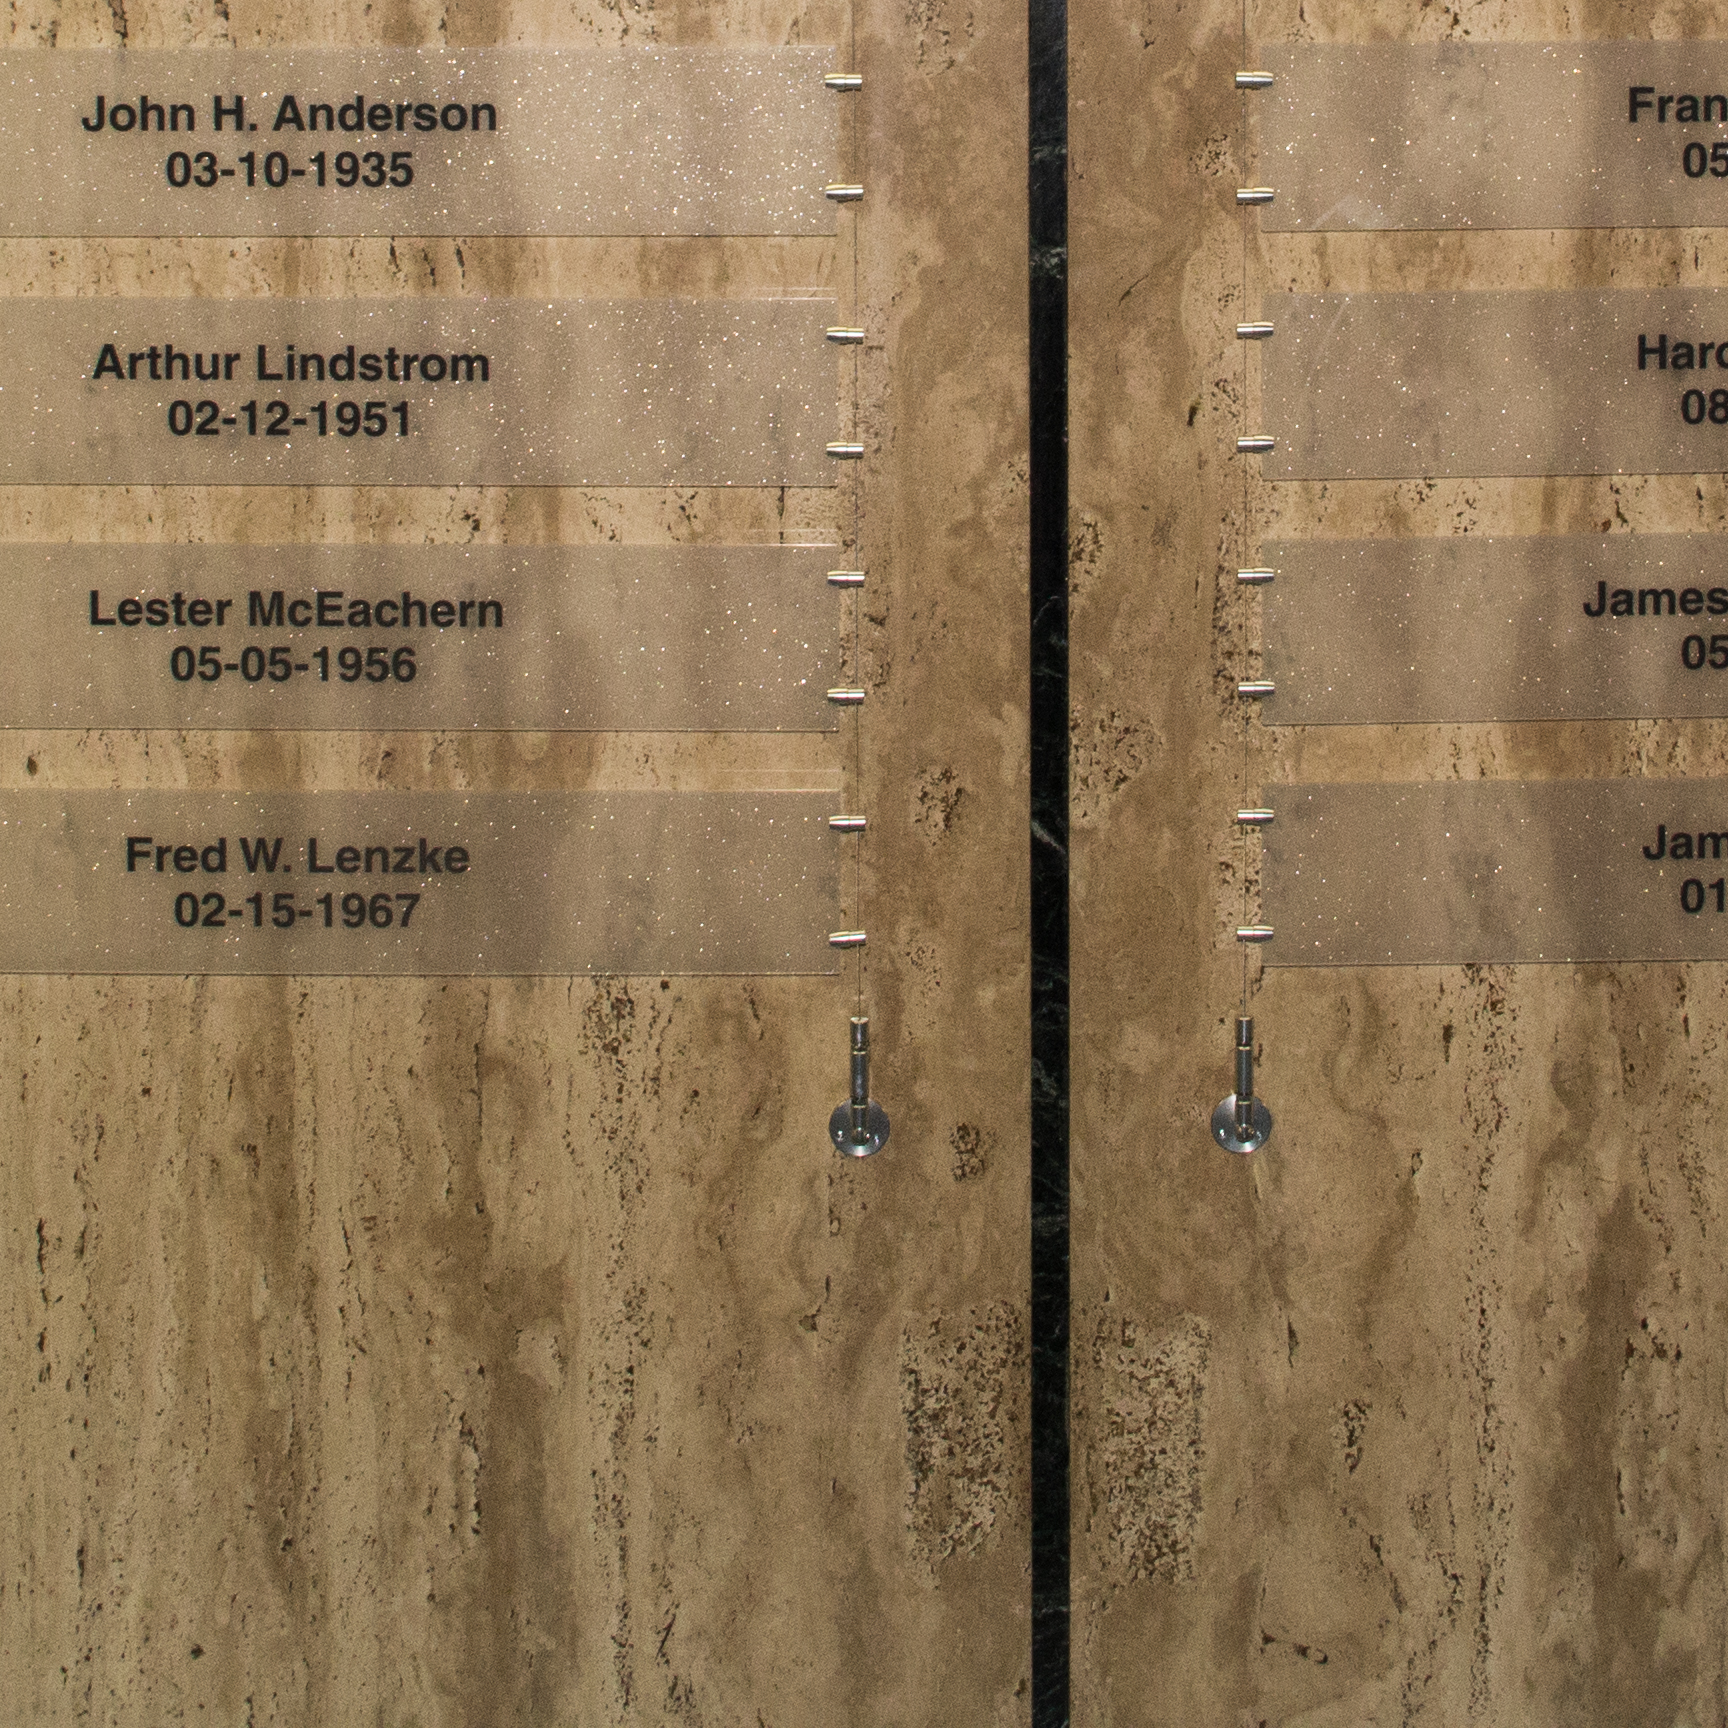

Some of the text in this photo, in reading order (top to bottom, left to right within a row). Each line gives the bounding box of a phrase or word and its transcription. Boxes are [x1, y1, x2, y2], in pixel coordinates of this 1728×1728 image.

[82, 95, 496, 132] John H. Anderson
[166, 151, 414, 188] 03-10-1935
[94, 344, 489, 382] Arthur Lindstrom
[169, 401, 408, 437] 02-12-1951
[91, 591, 503, 628] Lester McEachern
[171, 646, 417, 683] 05-05-1956
[127, 837, 469, 874] Fred W. Lenzke
[175, 892, 420, 929] 02-15-1967
